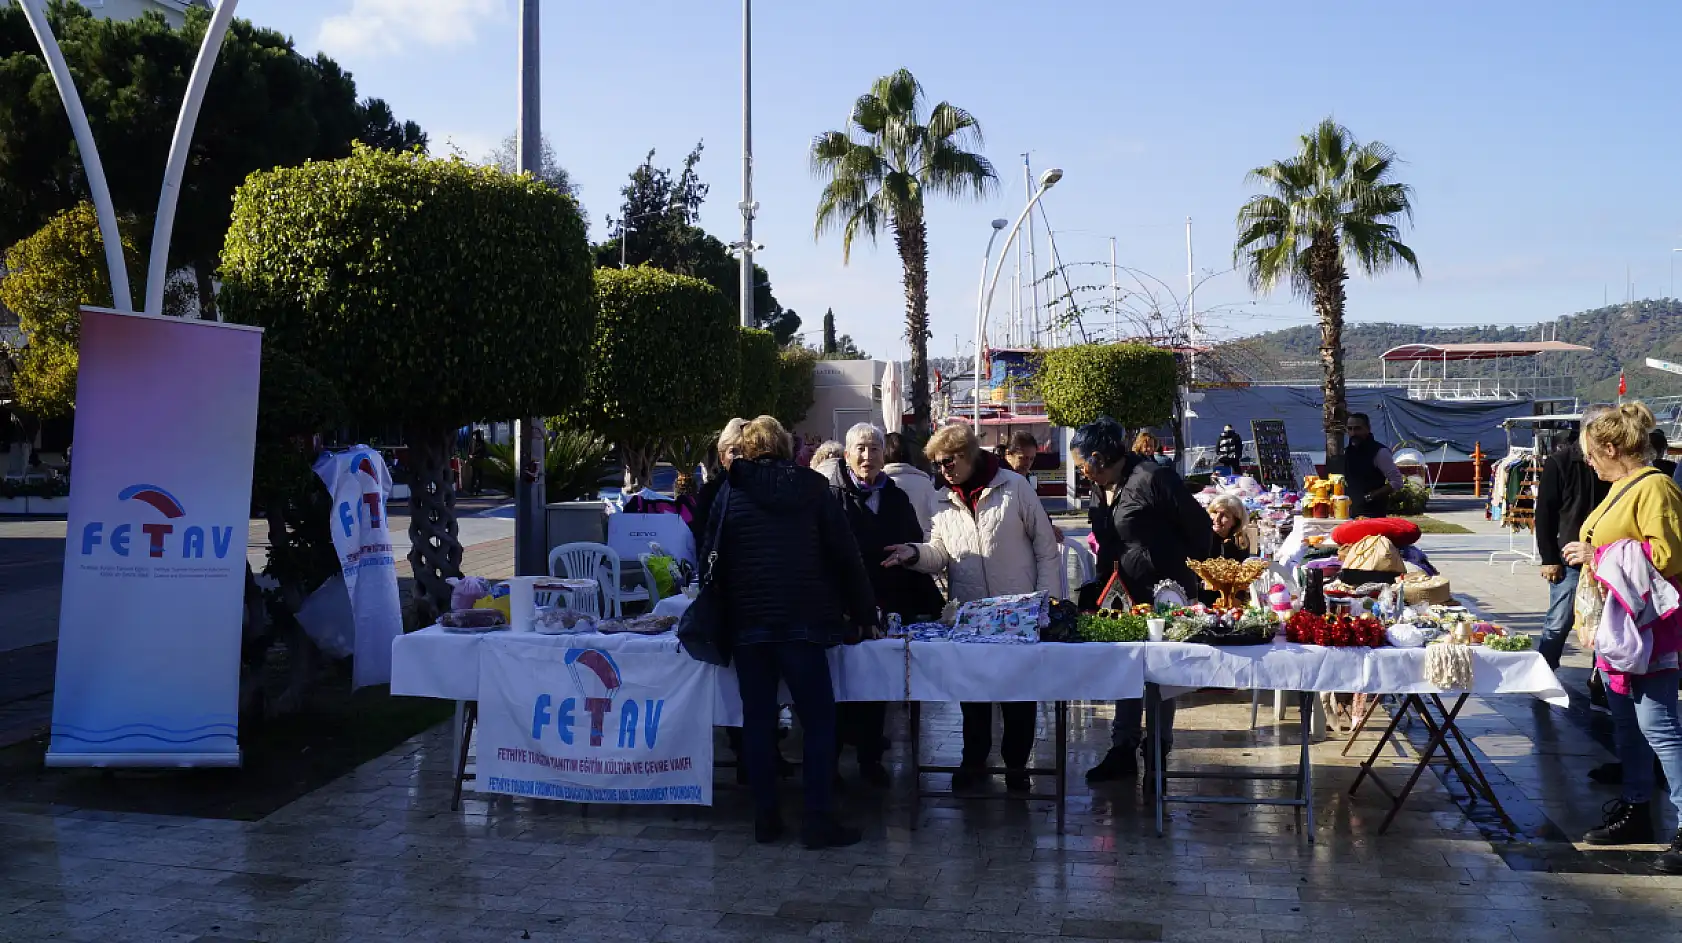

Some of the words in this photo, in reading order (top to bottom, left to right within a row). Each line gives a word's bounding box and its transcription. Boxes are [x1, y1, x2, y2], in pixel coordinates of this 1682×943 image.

[81, 521, 233, 559] FETAV
[532, 693, 665, 750] FETAV
[632, 762, 643, 774] VE
[644, 760, 669, 776] ÇEVRE
[669, 757, 692, 771] VAKFI
